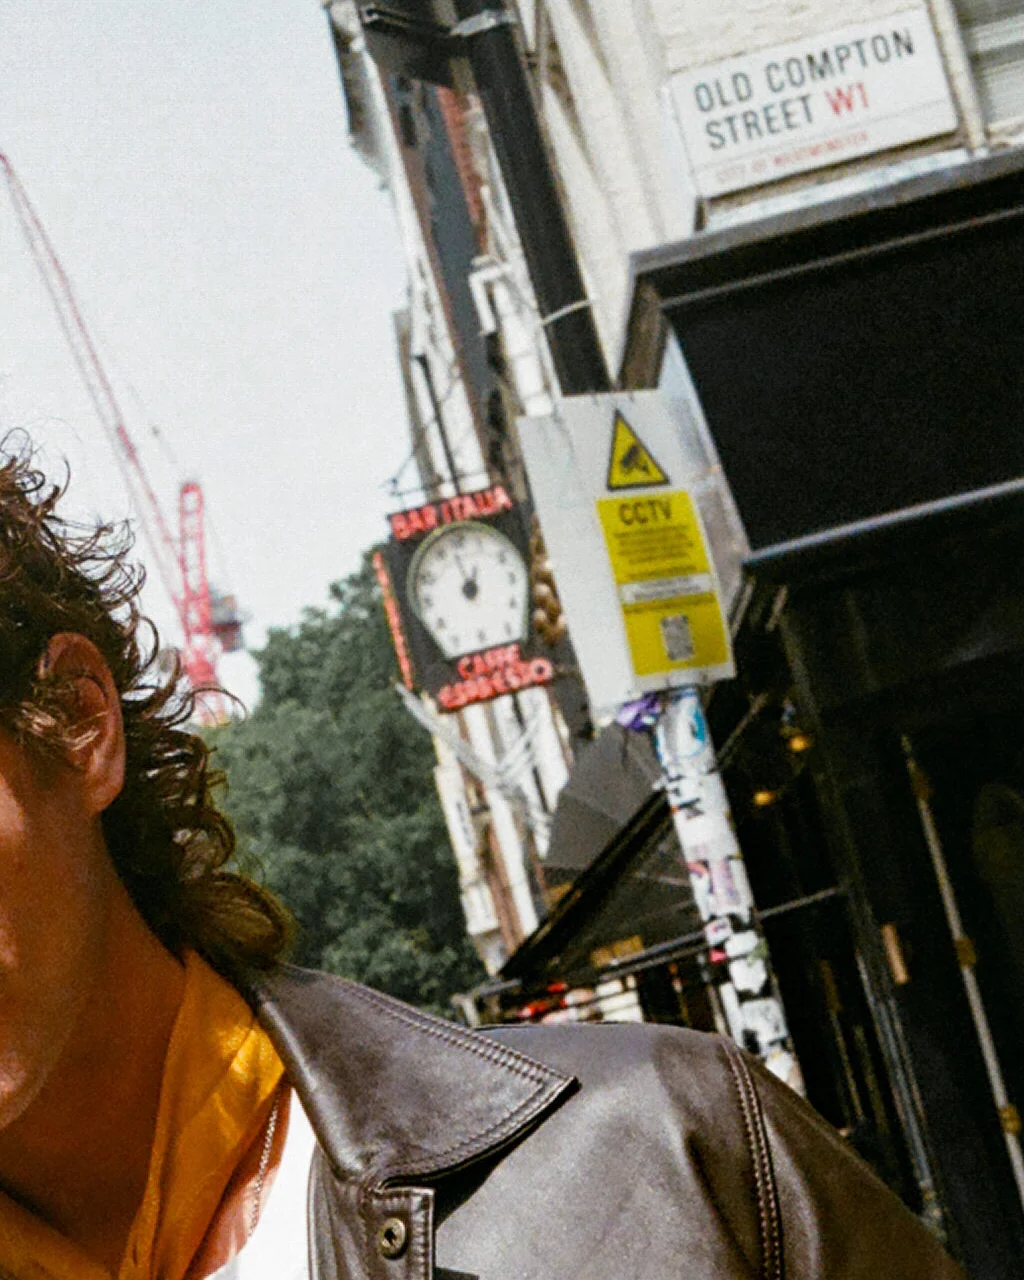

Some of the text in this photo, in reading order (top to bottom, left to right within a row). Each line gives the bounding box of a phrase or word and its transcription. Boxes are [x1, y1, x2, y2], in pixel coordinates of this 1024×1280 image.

[693, 29, 916, 114] OLD COMPTON
[704, 81, 870, 150] STREET W1
[618, 500, 673, 525] CCTV
